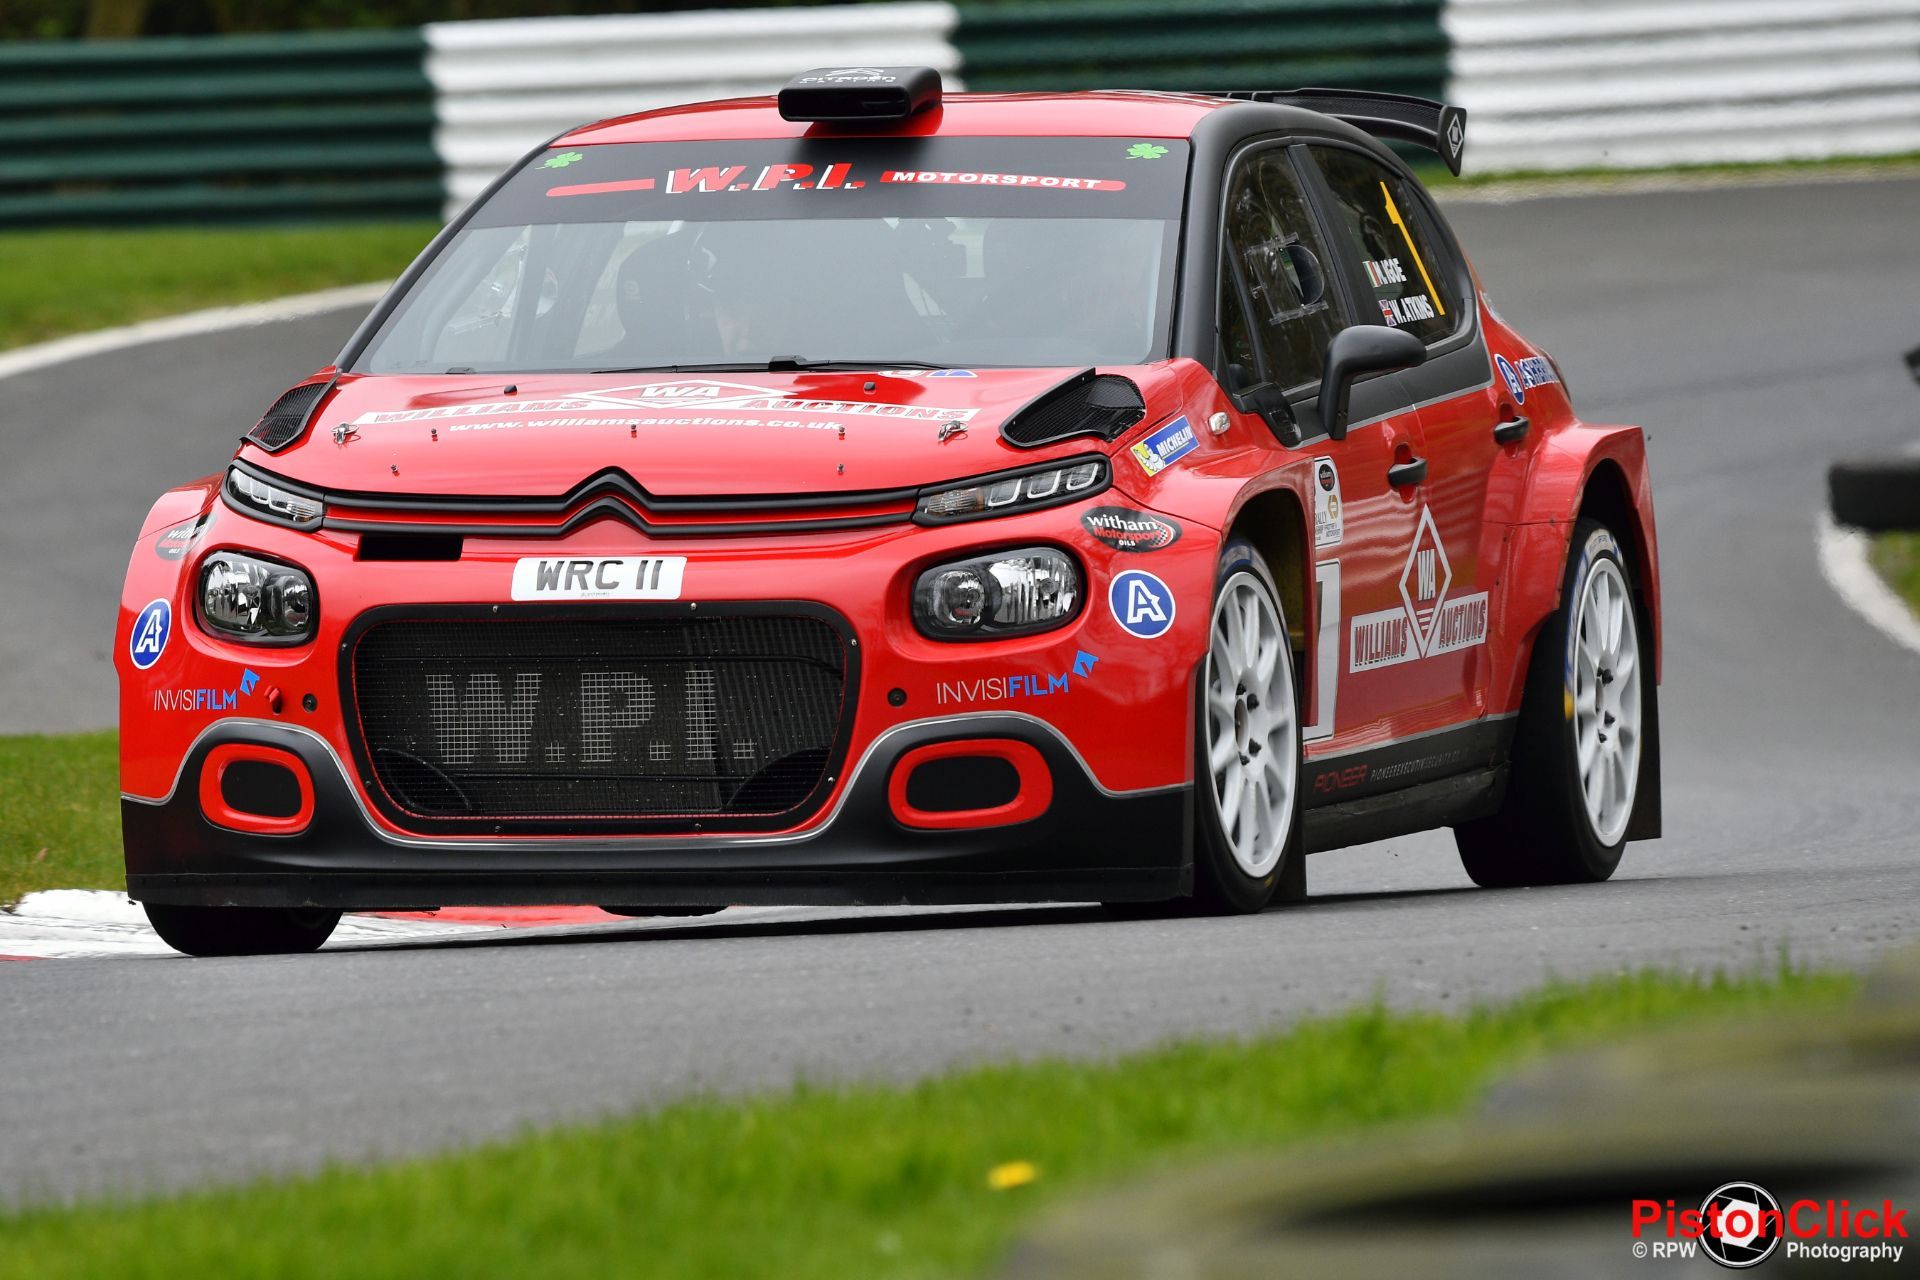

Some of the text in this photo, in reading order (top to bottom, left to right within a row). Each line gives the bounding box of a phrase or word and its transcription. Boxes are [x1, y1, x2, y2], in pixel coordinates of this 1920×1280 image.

[665, 163, 1101, 194] W.P.I. MOTORSPORT
[641, 386, 721, 398] WA
[375, 399, 969, 424] WILLIAMS AUCTIONS
[449, 417, 843, 432] www.williamsauctions.co.uk
[1156, 426, 1194, 457] MICHELIN
[1087, 514, 1158, 532] witham
[1118, 539, 1136, 547] OILS
[536, 560, 664, 591] WRC 11
[1417, 548, 1436, 601] WA
[1354, 600, 1486, 667] WILLIAMS AUCTIONS
[154, 688, 238, 711] INVISIFILM
[936, 672, 1069, 705] INVISIFILM
[424, 670, 756, 764] W.P.I.
